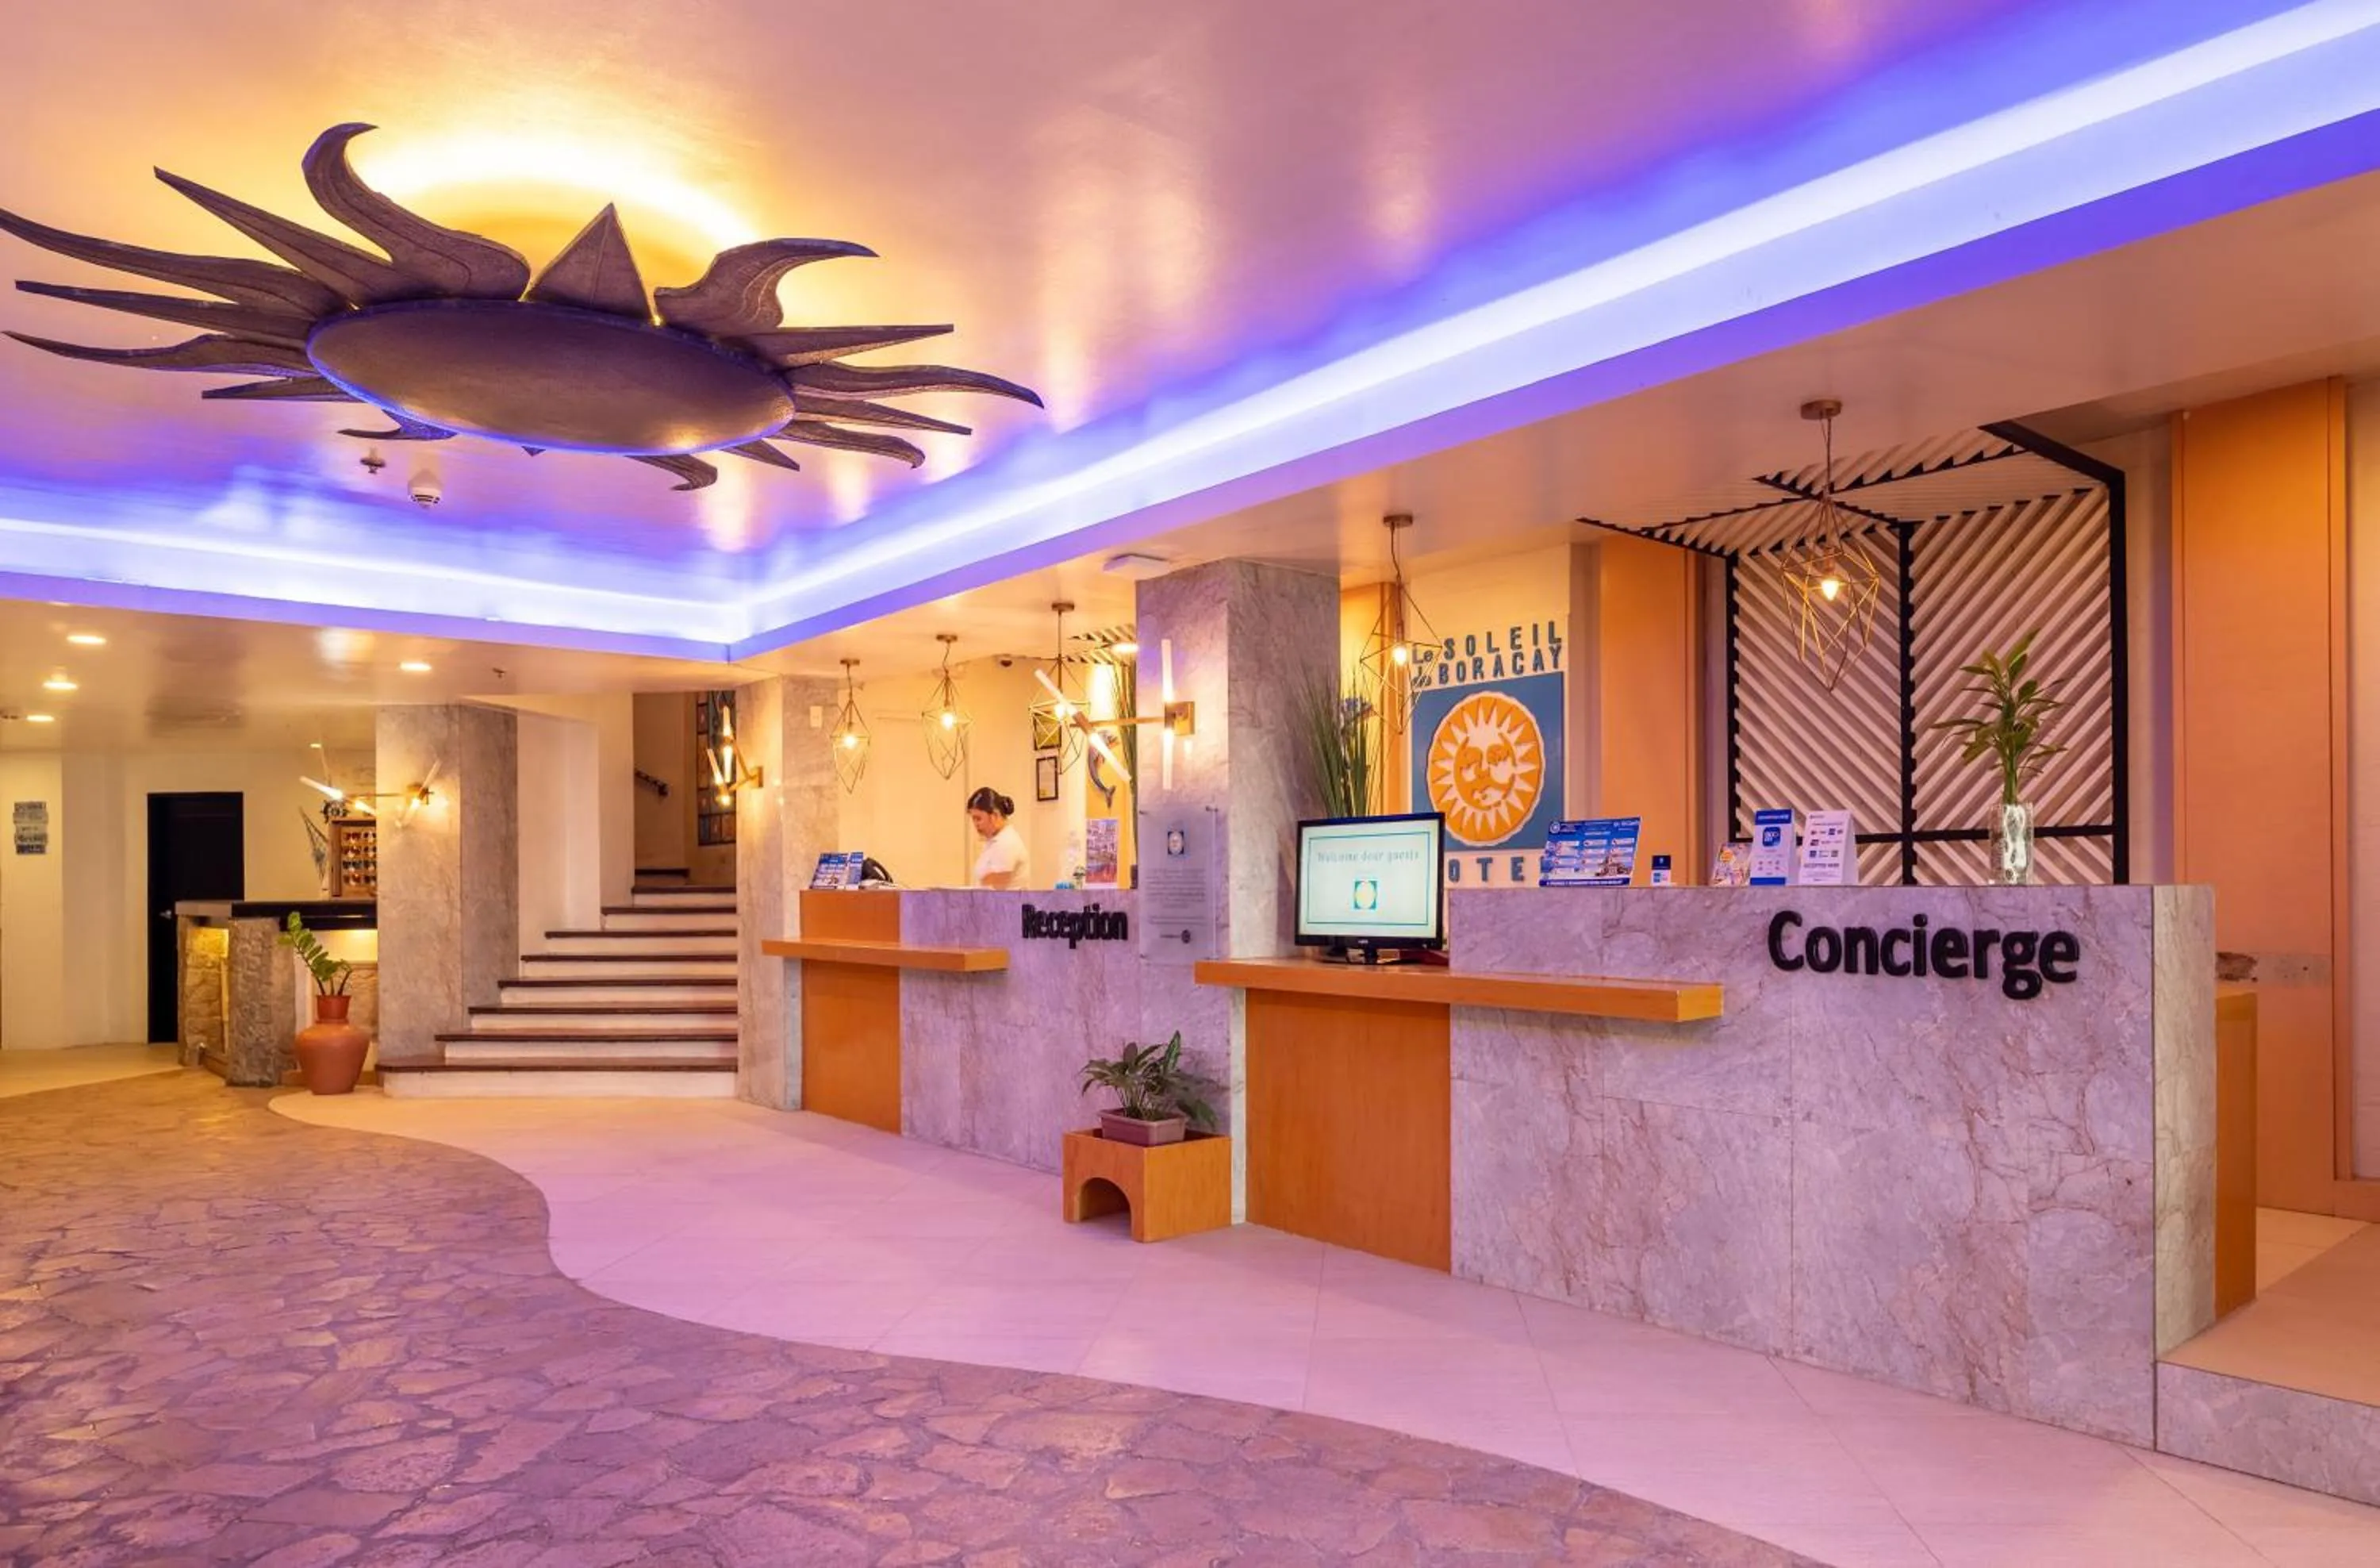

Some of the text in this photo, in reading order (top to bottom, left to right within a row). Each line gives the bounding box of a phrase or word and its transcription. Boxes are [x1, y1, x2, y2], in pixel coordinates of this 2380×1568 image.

[1412, 621, 1561, 663] Le SOLEIL
[1438, 644, 1561, 685] BORACAY
[1448, 856, 1547, 882] OTE
[1021, 903, 1128, 949] Reception
[1768, 910, 2080, 1000] Concierge
